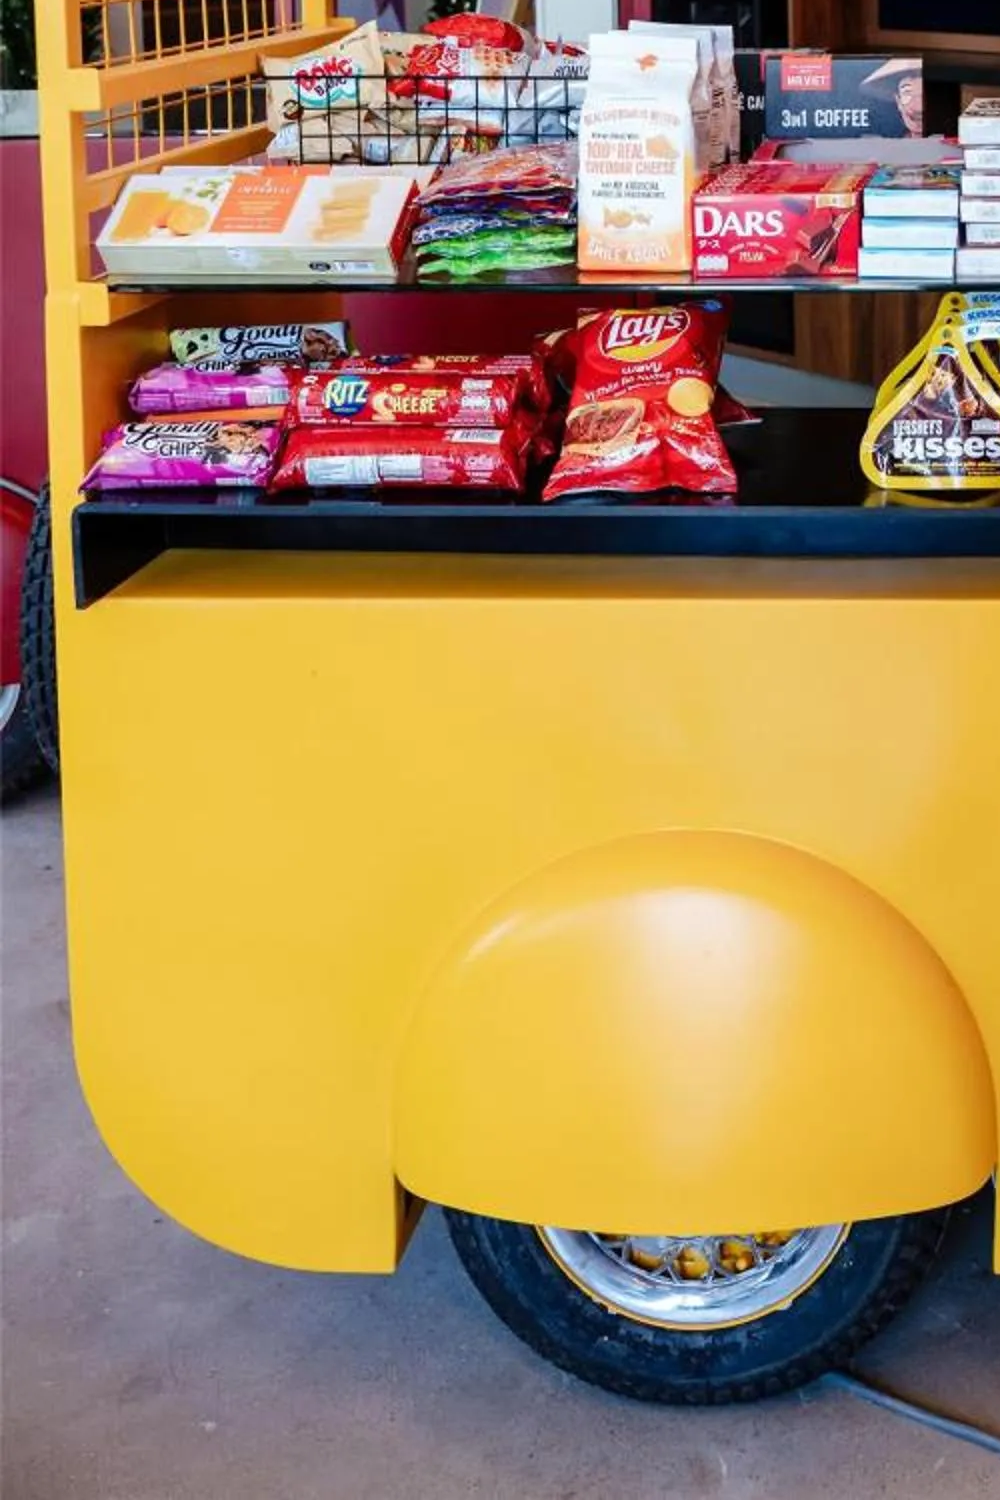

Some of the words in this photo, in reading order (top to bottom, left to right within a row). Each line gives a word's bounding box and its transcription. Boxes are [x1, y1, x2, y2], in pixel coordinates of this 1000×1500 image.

[814, 109, 870, 127] COFFEE
[694, 206, 784, 237] DARS
[324, 377, 371, 409] RITZ
[159, 440, 205, 458] CHIPS
